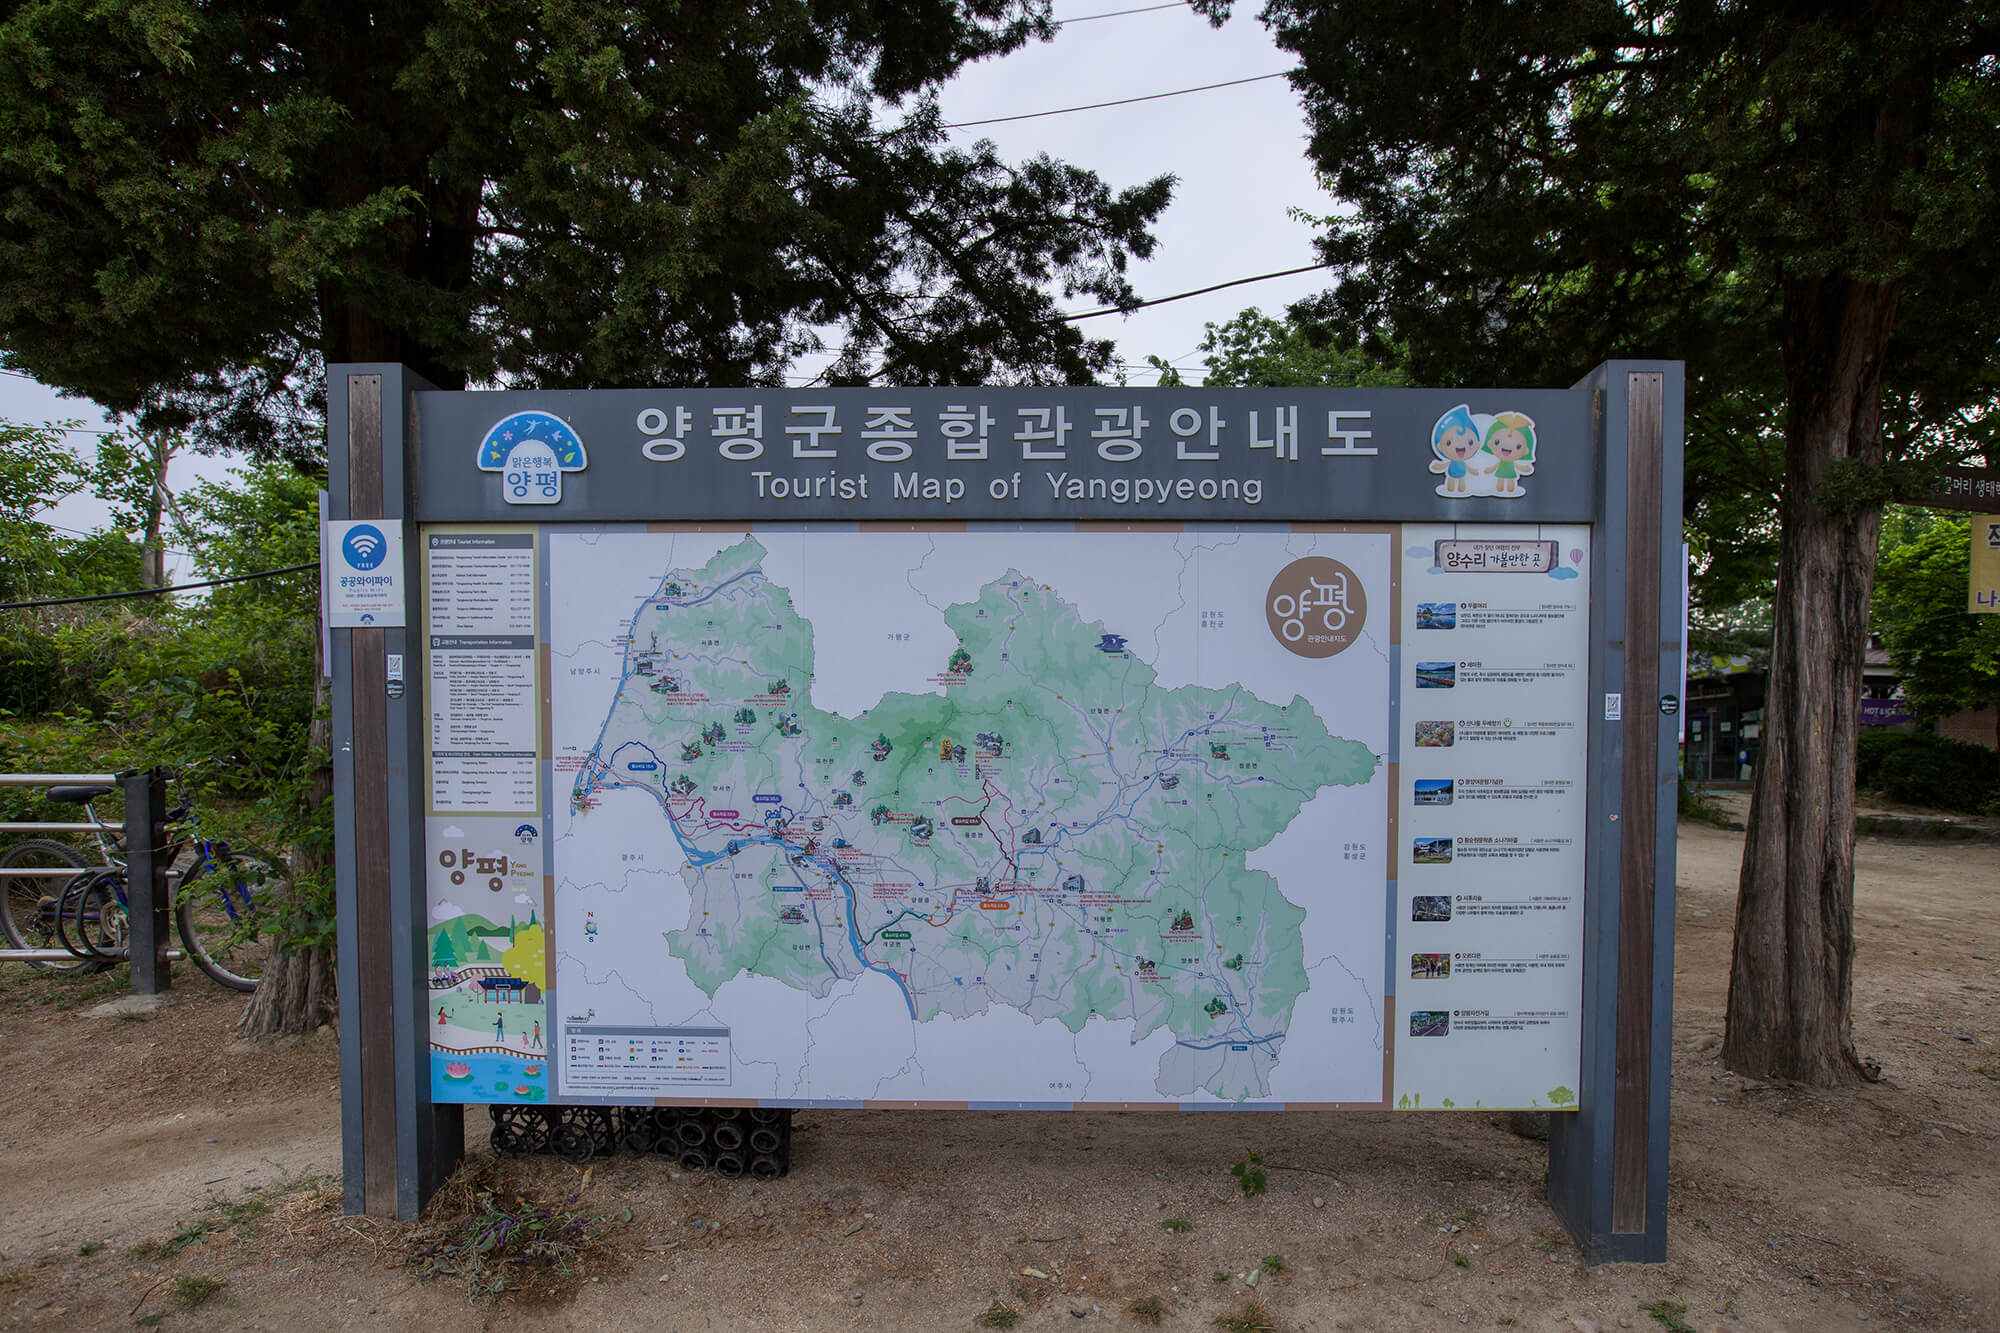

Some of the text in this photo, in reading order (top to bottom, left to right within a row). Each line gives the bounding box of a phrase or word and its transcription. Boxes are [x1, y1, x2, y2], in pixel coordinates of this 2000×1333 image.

[636, 404, 1379, 462] 양평군종합관광안내도
[512, 456, 552, 468] 맑은행복
[507, 471, 557, 497] 양평
[752, 471, 1263, 504] Tourist Map of Yangpyeong
[1447, 551, 1541, 568] 양수리 가볼만한 곳
[340, 576, 393, 587] 공공와이파이
[1273, 572, 1355, 641] 양평
[439, 848, 508, 892] 양평
